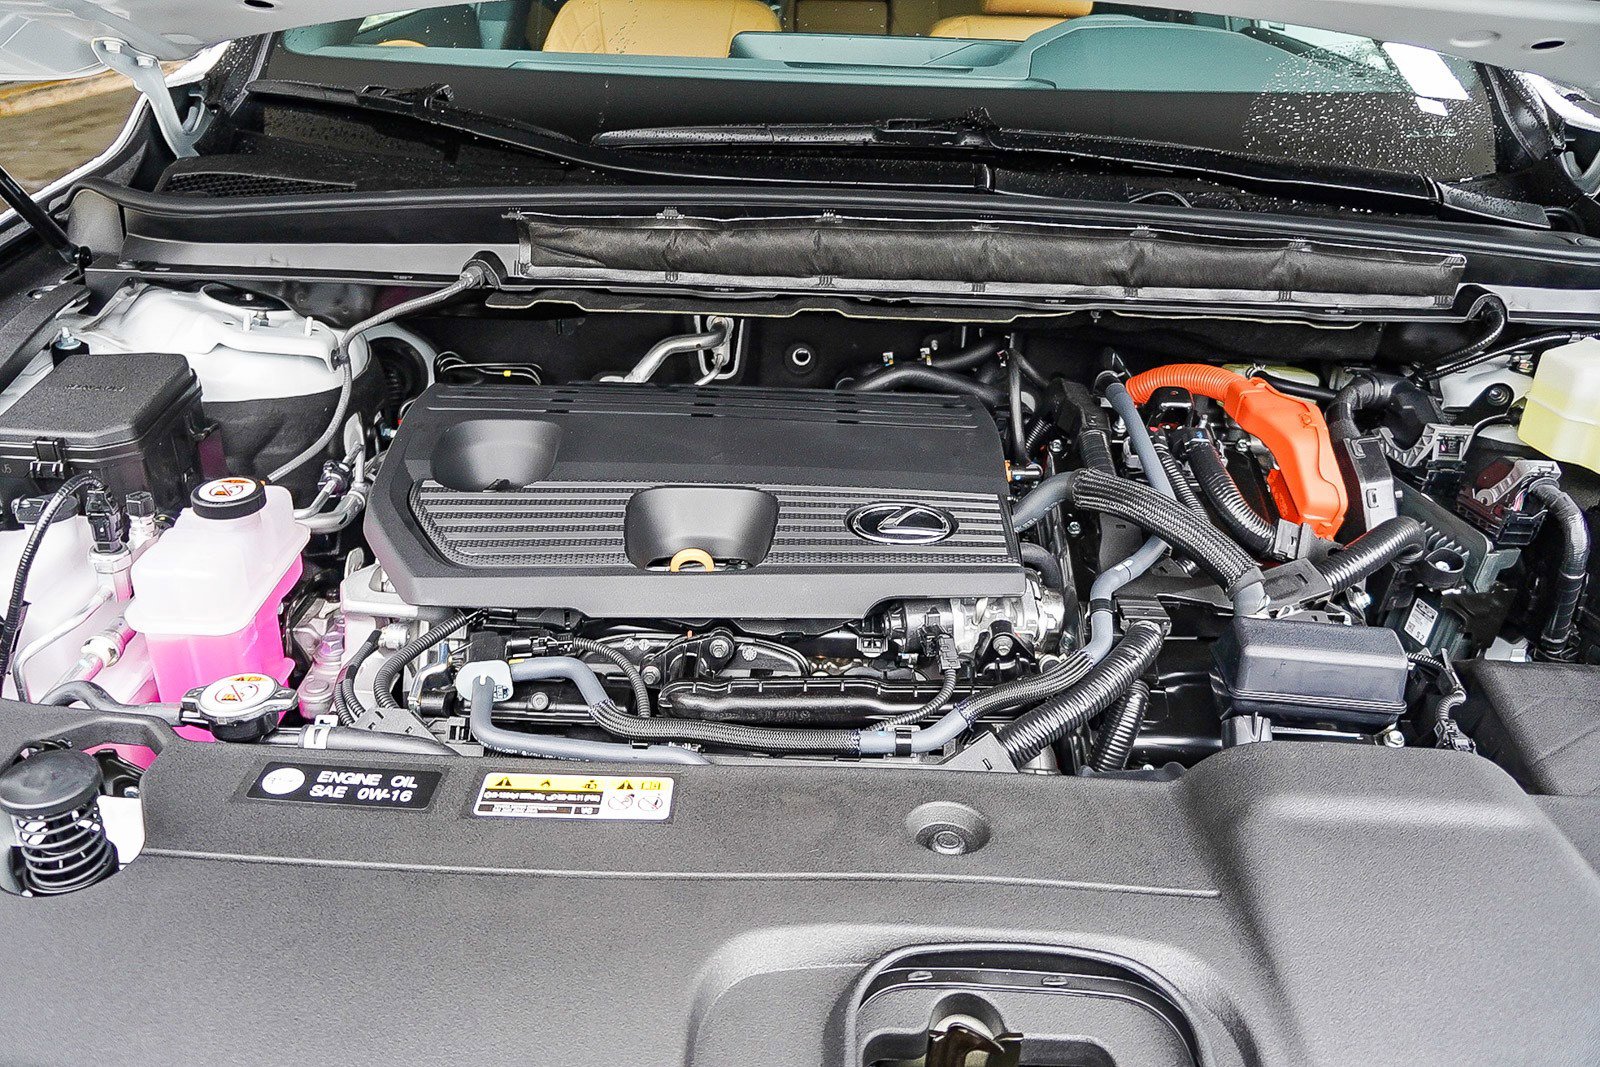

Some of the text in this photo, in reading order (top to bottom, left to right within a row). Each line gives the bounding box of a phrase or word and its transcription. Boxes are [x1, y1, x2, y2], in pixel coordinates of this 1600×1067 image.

[316, 770, 419, 789] ENGINE OIL
[309, 785, 413, 803] SAE 0W-16
